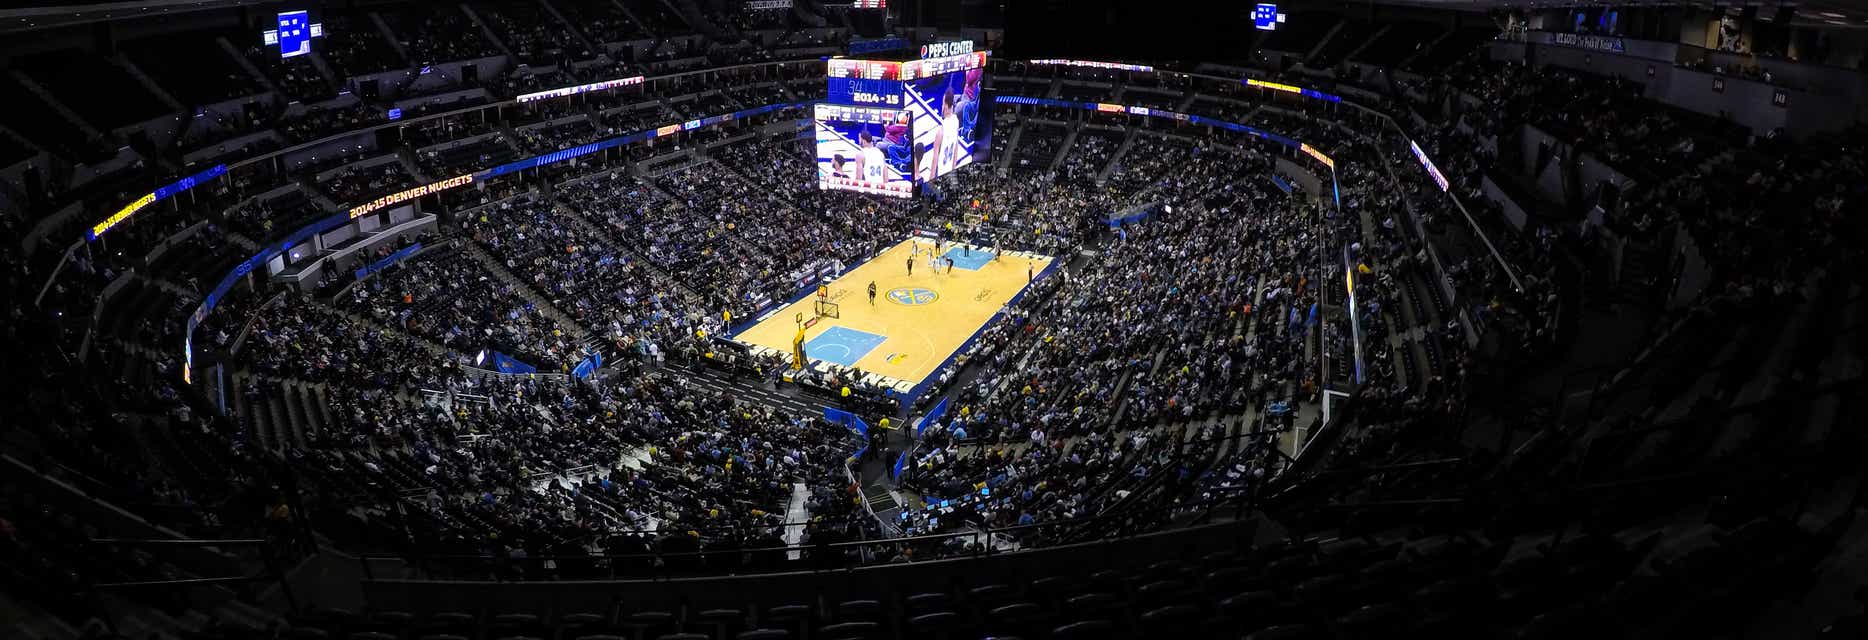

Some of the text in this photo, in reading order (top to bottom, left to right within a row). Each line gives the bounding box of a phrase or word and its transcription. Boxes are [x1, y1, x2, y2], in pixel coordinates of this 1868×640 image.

[928, 40, 974, 58] PEPSI CENTER
[349, 174, 473, 219] 2014-15 DENVER NUGGETS
